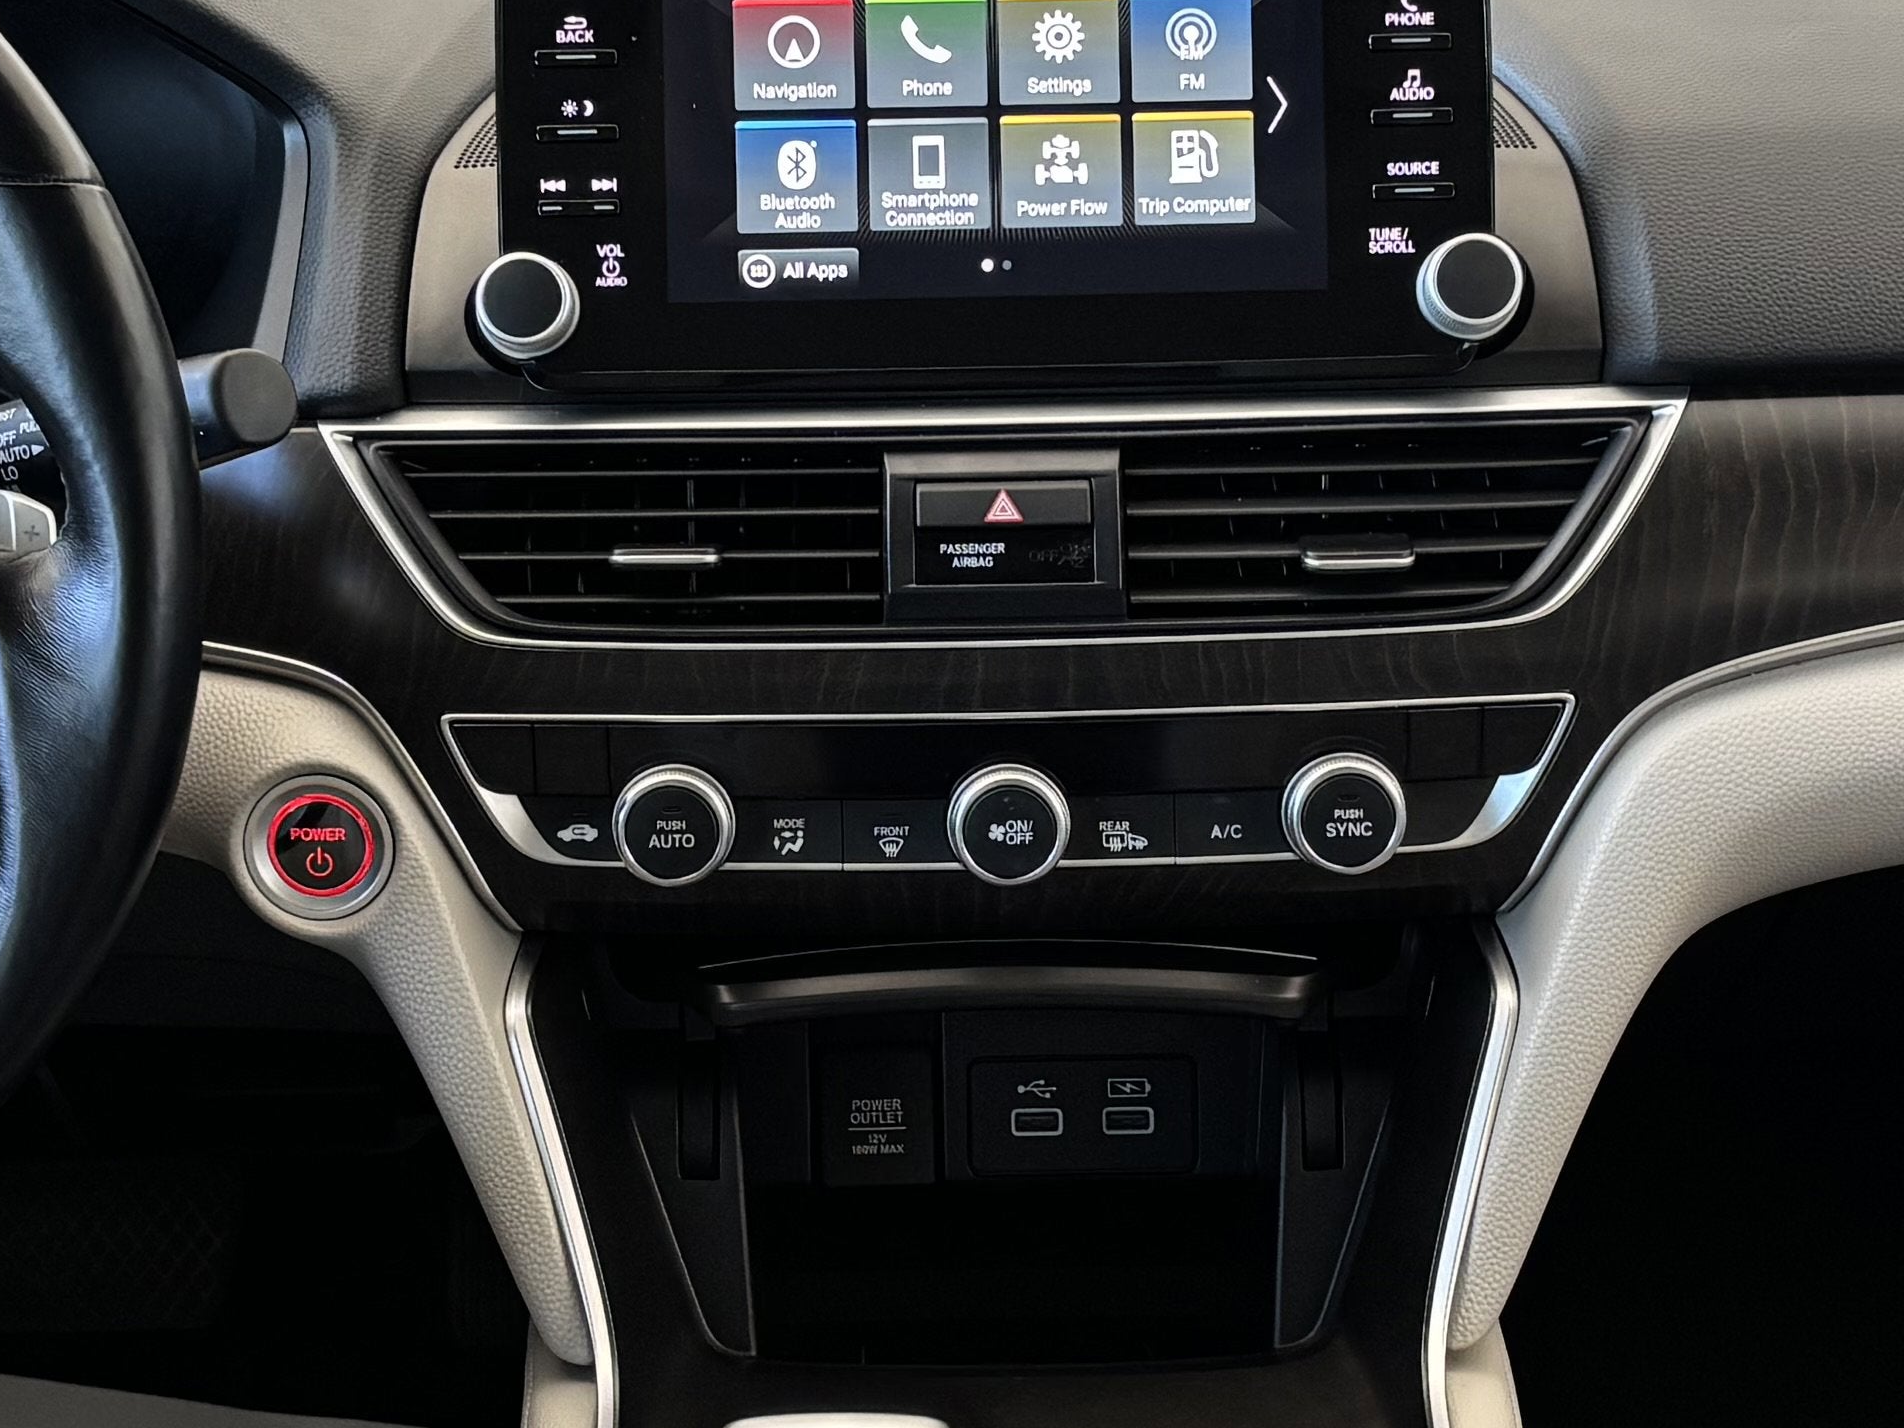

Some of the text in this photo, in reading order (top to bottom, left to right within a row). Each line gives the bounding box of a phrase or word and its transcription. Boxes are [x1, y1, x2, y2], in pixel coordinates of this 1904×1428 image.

[1385, 12, 1435, 26] PHONE
[556, 30, 595, 43] BACK
[902, 79, 952, 96] Phone
[1027, 76, 1092, 96] Settings
[1179, 73, 1205, 90] FM
[753, 82, 837, 102] Navigation
[1389, 87, 1435, 101] AUDIO
[1386, 161, 1440, 176] SOURCE
[760, 192, 836, 211] Bluetooth
[881, 190, 979, 210] Smartphone
[1138, 196, 1251, 216] Trip Computer
[1016, 198, 1108, 217] Power Flow
[775, 212, 822, 229] Audio
[885, 209, 974, 227] Connection
[1368, 227, 1409, 241] TUNE/
[596, 243, 625, 257] VOL
[1368, 240, 1416, 254] SCROLL
[783, 261, 848, 281] All Apps
[595, 276, 628, 287] AUDIO
[0, 444, 31, 465] AUTO
[0, 465, 19, 481] LO
[939, 543, 1006, 555] PASSENGER
[952, 557, 994, 568] AIRBAG
[1333, 808, 1364, 820] PUSH
[656, 820, 687, 831] PUSH
[773, 819, 806, 829] MODE
[873, 825, 910, 837] FRONT
[1006, 819, 1033, 834] ON/
[1099, 821, 1130, 832] REAR
[1325, 821, 1374, 838] SYNC
[290, 828, 346, 841] POWER
[1006, 832, 1034, 846] OFF
[1211, 824, 1242, 840] A/C
[649, 833, 695, 849] AUTO
[851, 1098, 902, 1112] POWER
[850, 1111, 905, 1124] OUTLET
[867, 1133, 887, 1145] 12V
